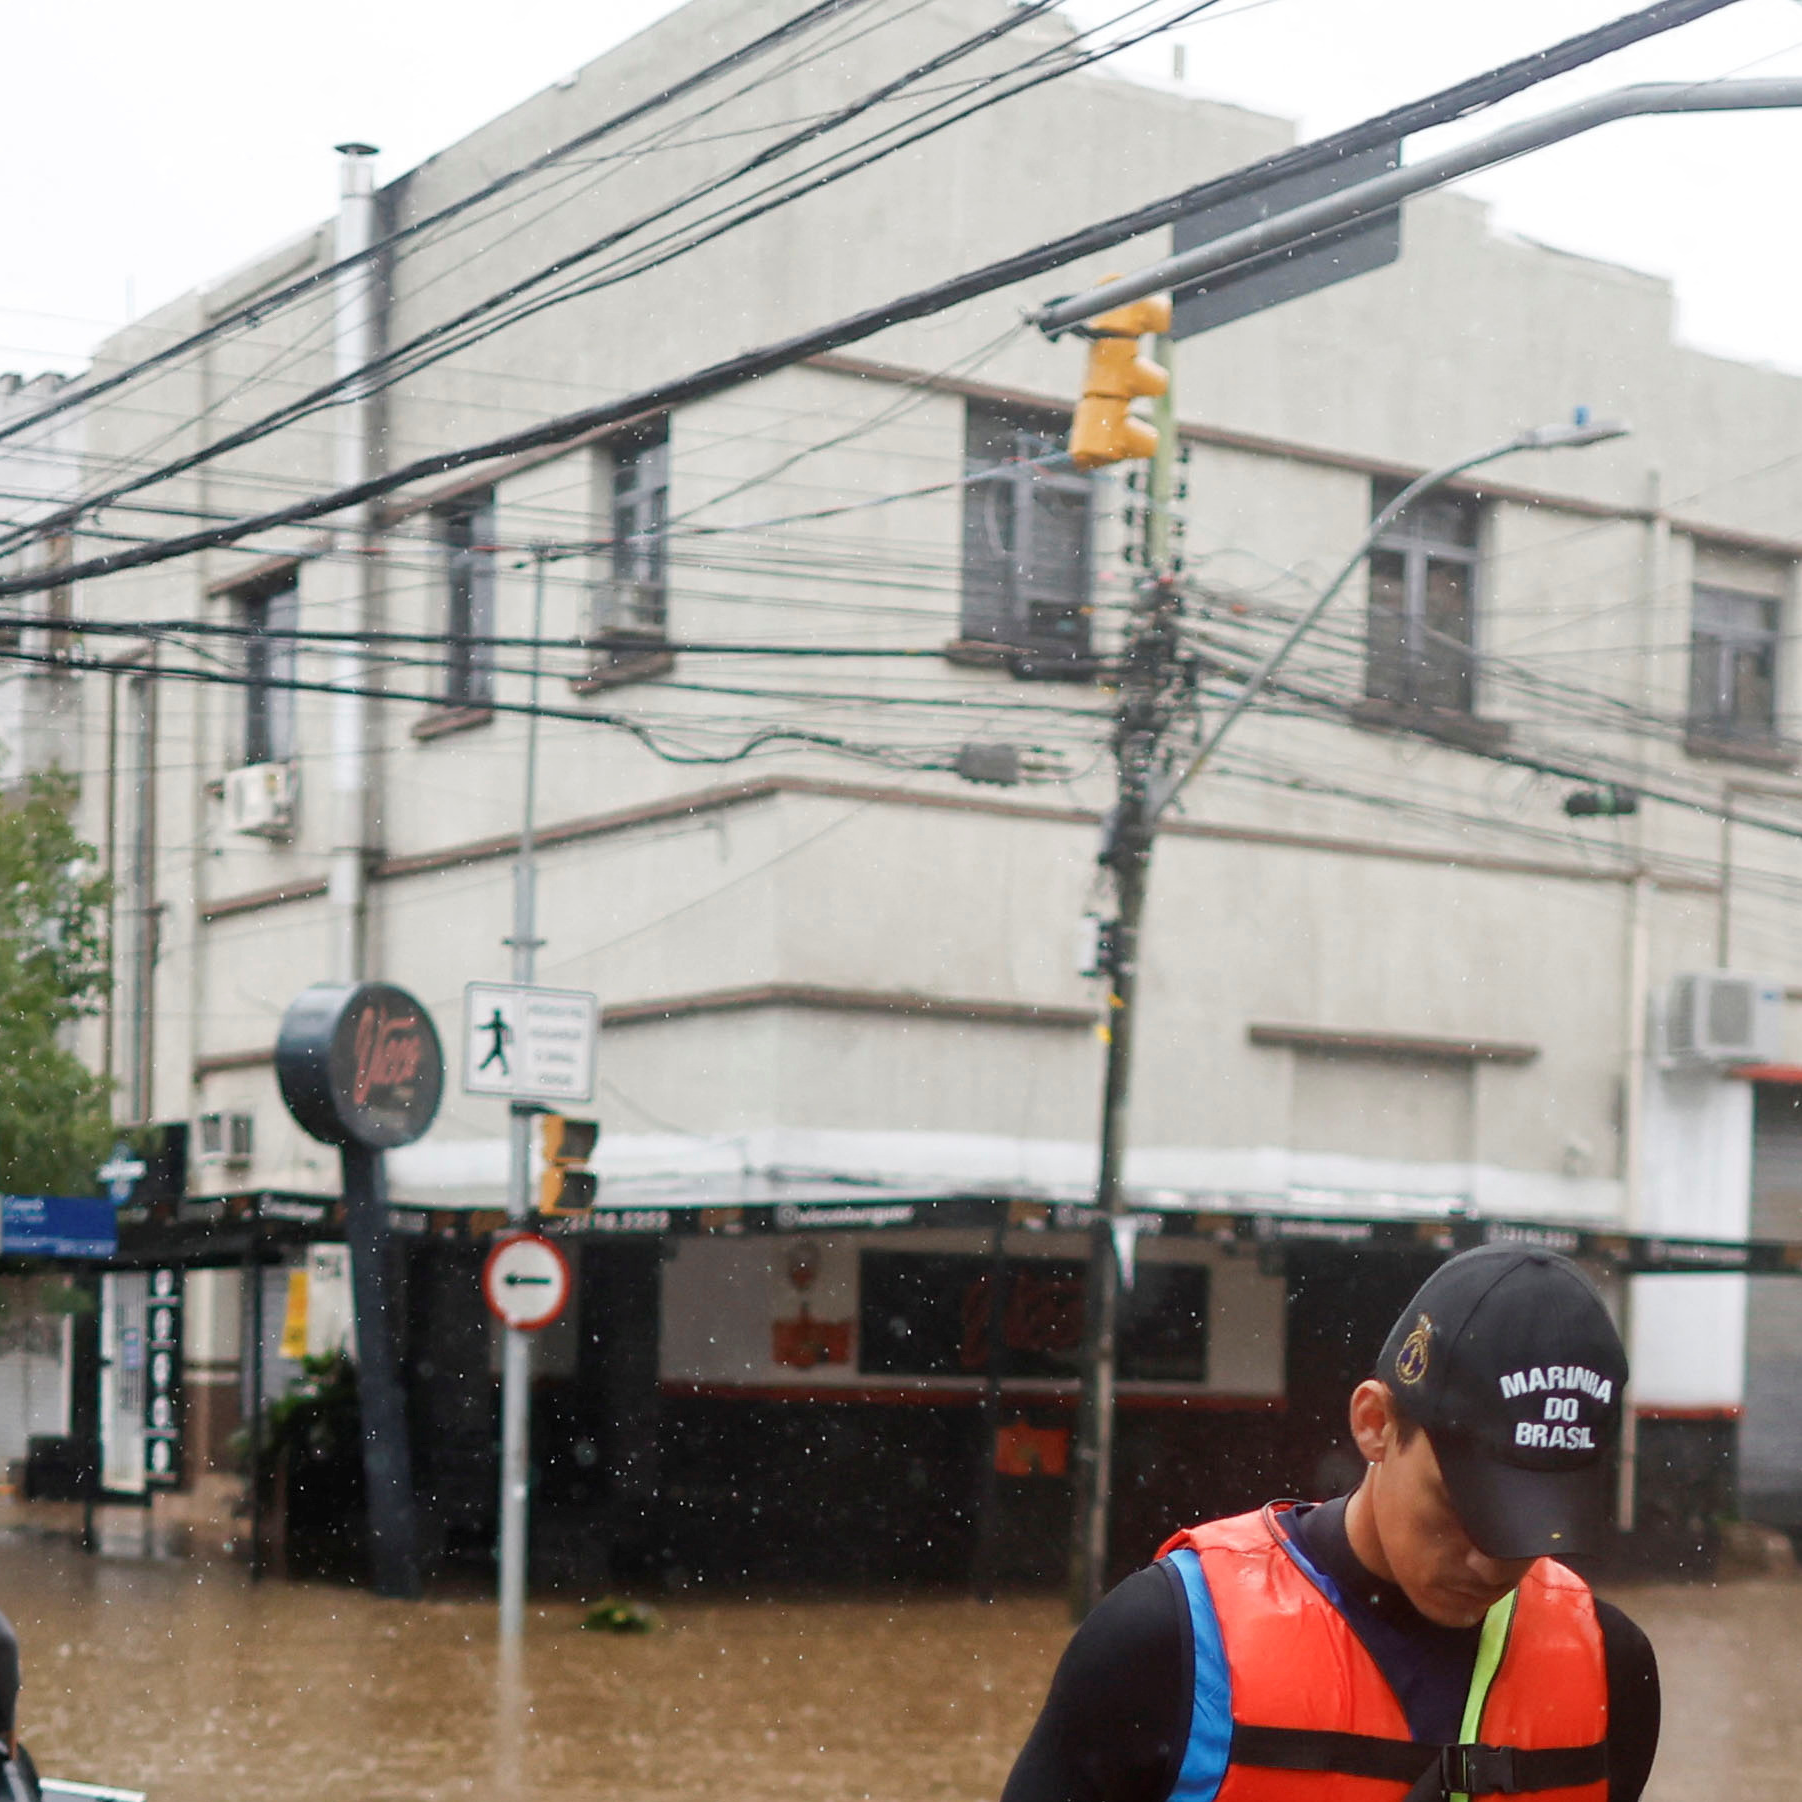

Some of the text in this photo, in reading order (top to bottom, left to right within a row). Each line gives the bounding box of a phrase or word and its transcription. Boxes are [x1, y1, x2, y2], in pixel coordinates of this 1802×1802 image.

[1499, 1365, 1613, 1404] MARINHA
[1544, 1397, 1579, 1422] DO
[1514, 1422, 1595, 1450] BRASIL
